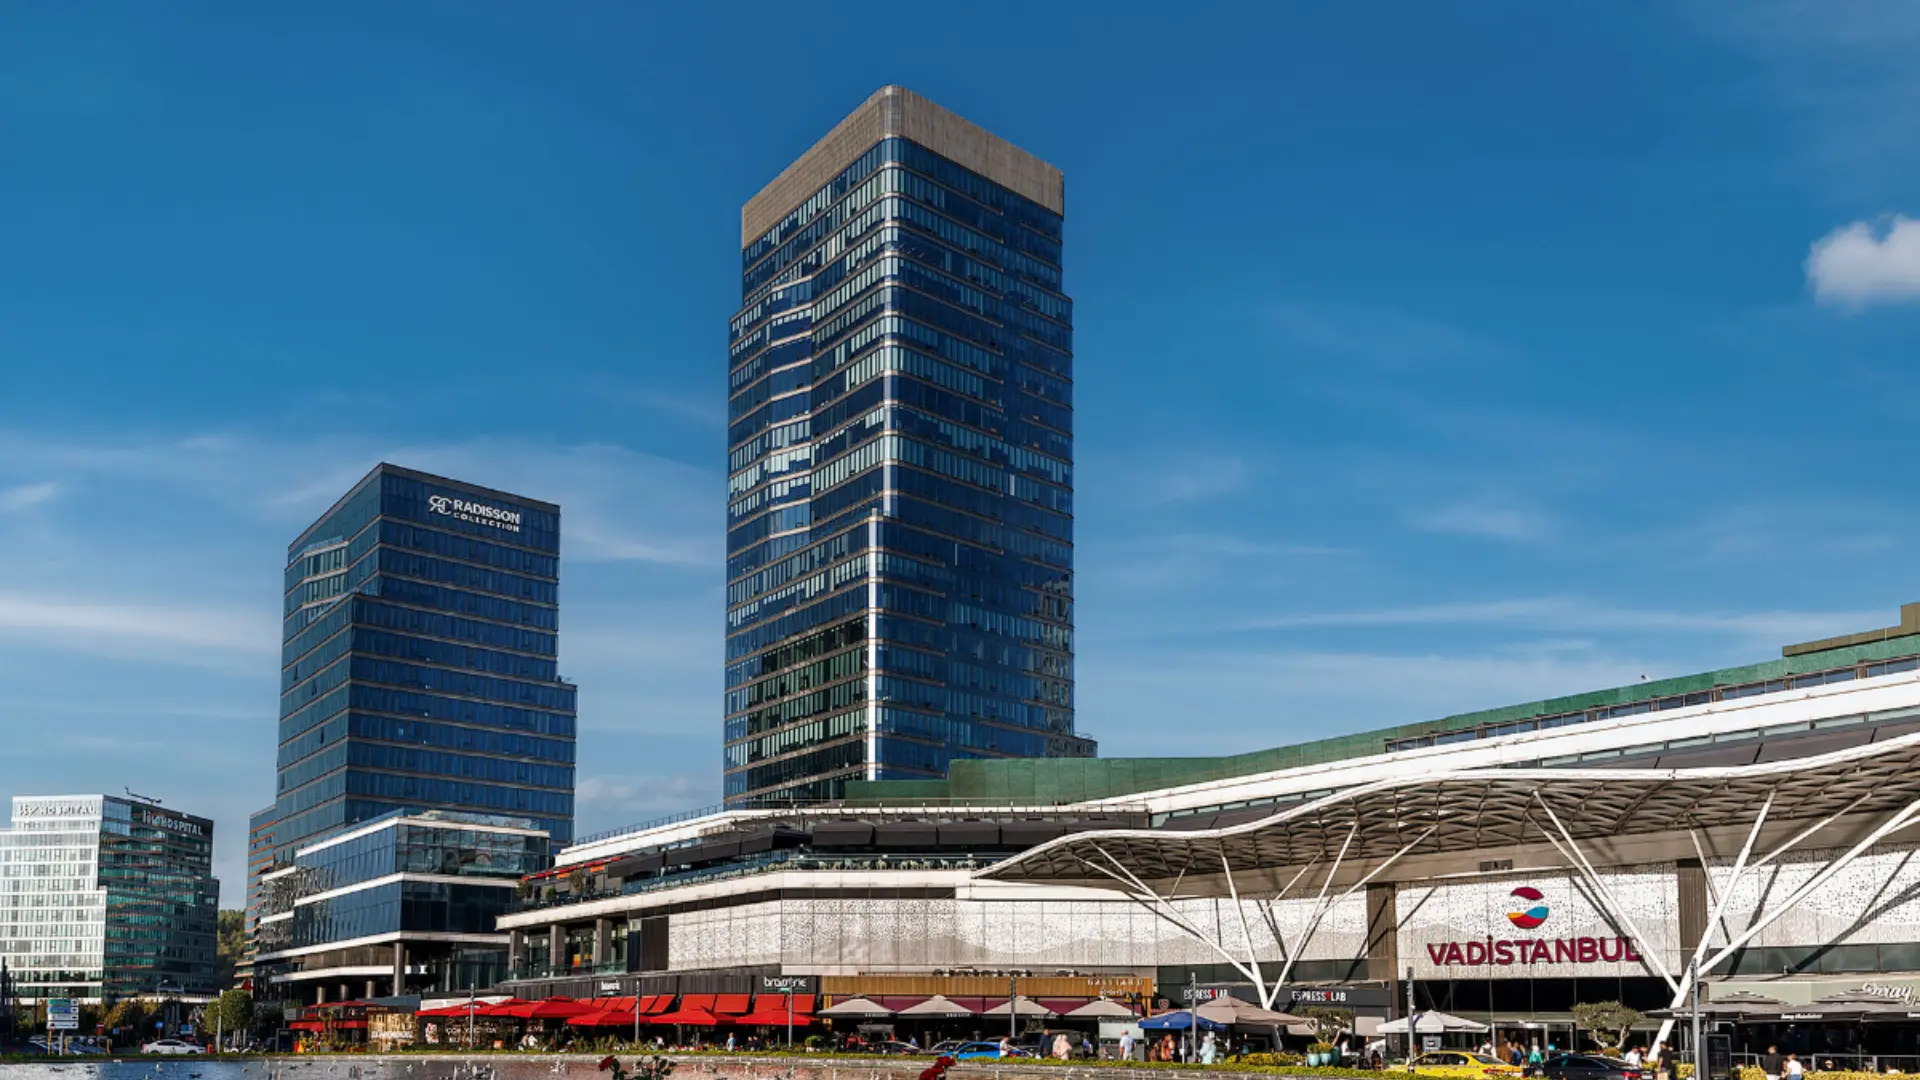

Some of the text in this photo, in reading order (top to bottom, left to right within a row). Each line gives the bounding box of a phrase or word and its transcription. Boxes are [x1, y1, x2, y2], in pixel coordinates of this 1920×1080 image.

[453, 499, 520, 524] RADISSON
[453, 512, 519, 532] COLLECTION
[161, 816, 203, 836] HOSPITAL
